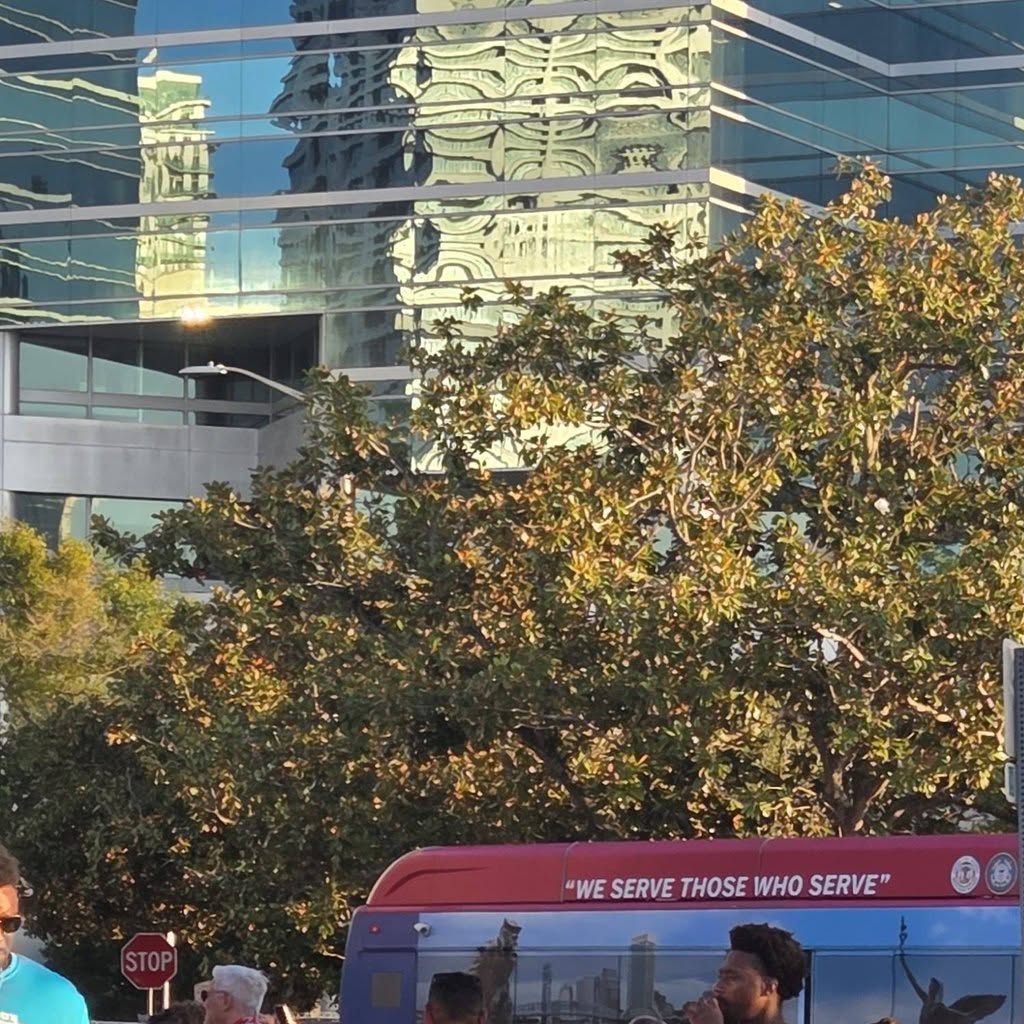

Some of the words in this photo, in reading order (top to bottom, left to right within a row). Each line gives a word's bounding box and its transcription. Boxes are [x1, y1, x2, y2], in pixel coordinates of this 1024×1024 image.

[610, 877, 675, 899] SERVE
[680, 876, 748, 897] THOSE
[753, 875, 803, 896] WHO
[125, 951, 173, 971] STOP
